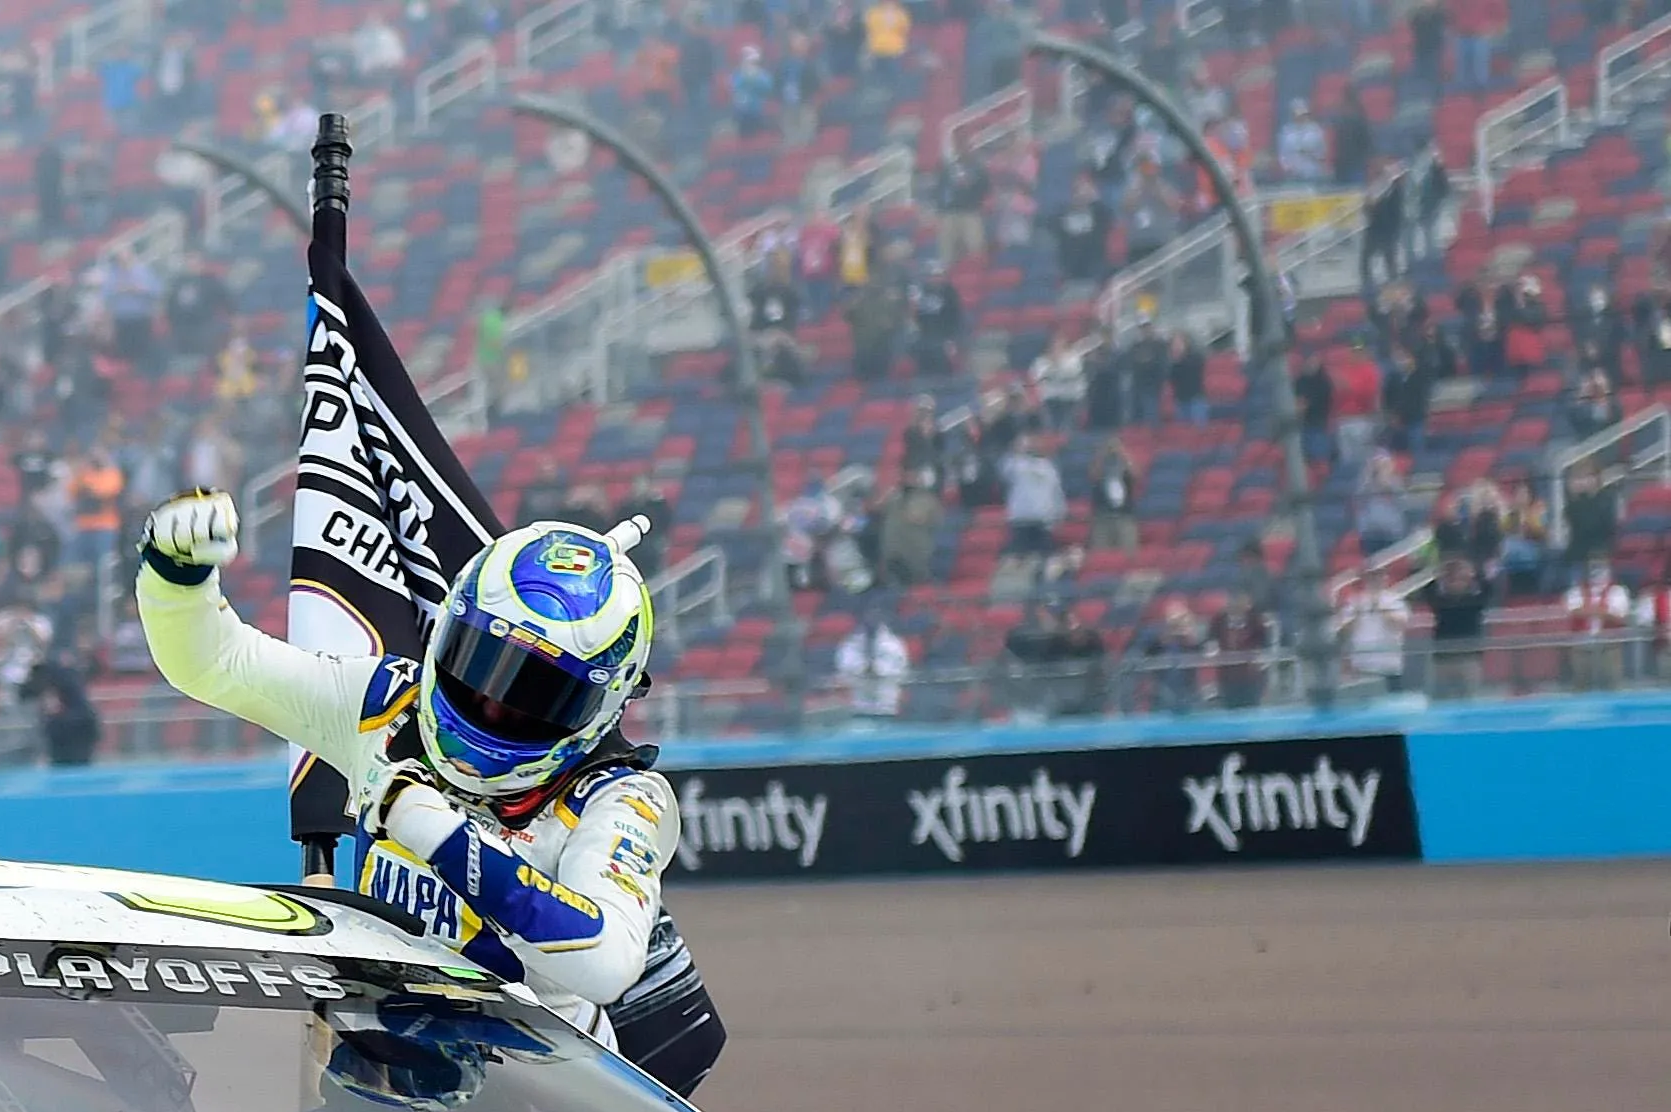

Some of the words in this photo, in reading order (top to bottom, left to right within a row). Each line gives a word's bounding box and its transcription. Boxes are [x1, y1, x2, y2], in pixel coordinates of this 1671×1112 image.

[907, 764, 1097, 863] xfinity
[1184, 752, 1380, 852] xfinity
[371, 855, 458, 939] NAPA
